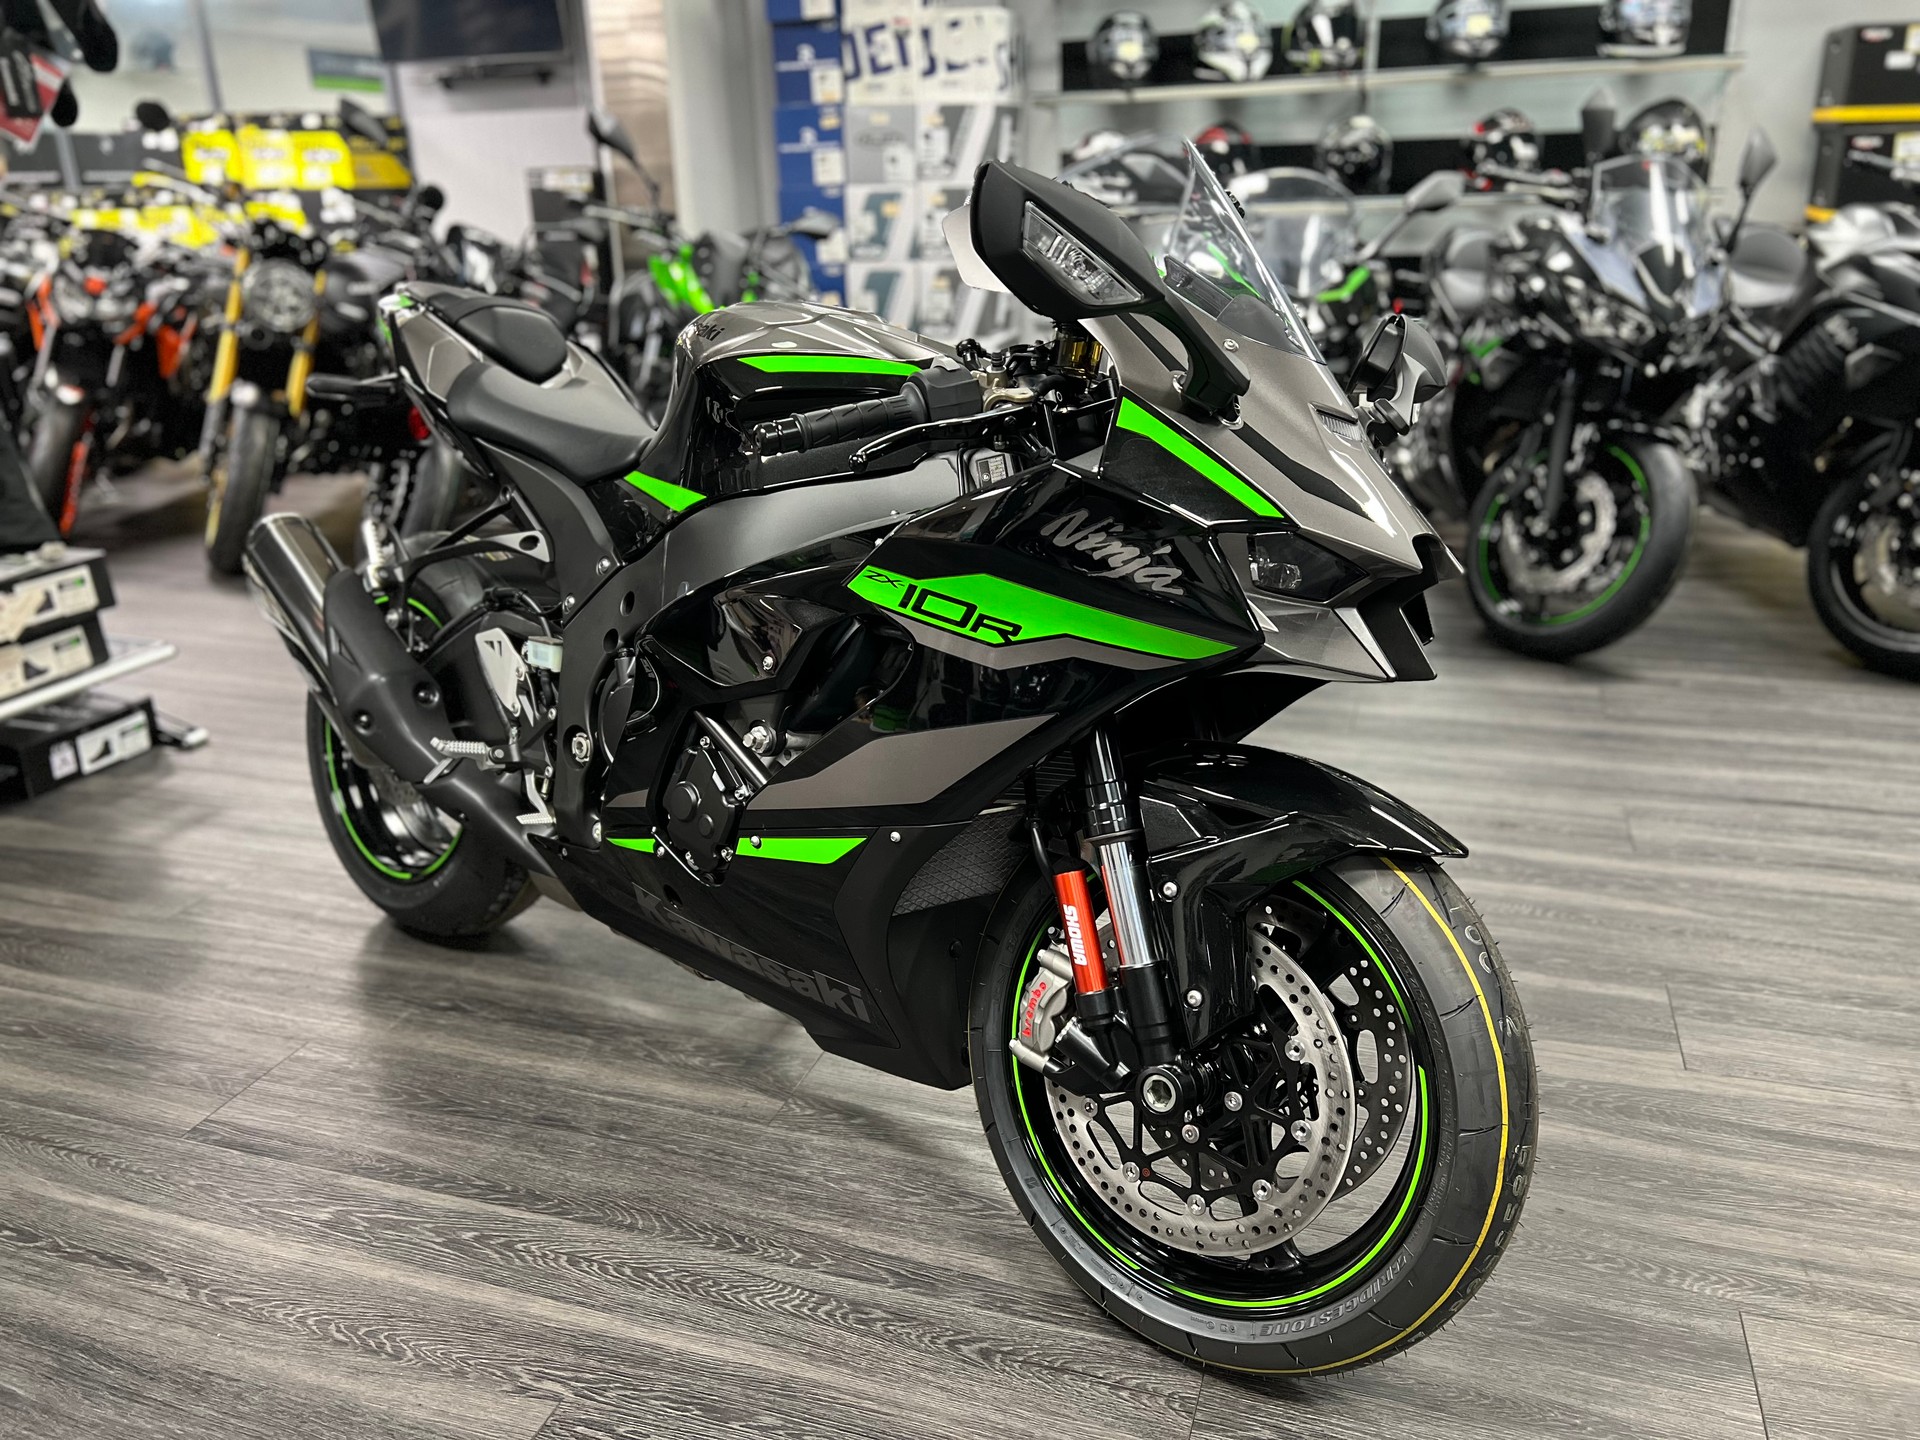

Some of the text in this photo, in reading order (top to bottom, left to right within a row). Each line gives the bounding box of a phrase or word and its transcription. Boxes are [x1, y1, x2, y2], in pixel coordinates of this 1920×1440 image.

[1040, 508, 1184, 596] Ninja
[632, 882, 871, 1024] Kawasaki
[1062, 904, 1088, 967] SHOWA
[1022, 981, 1047, 1037] brembo
[1259, 1255, 1407, 1337] BRIDGESTONE
